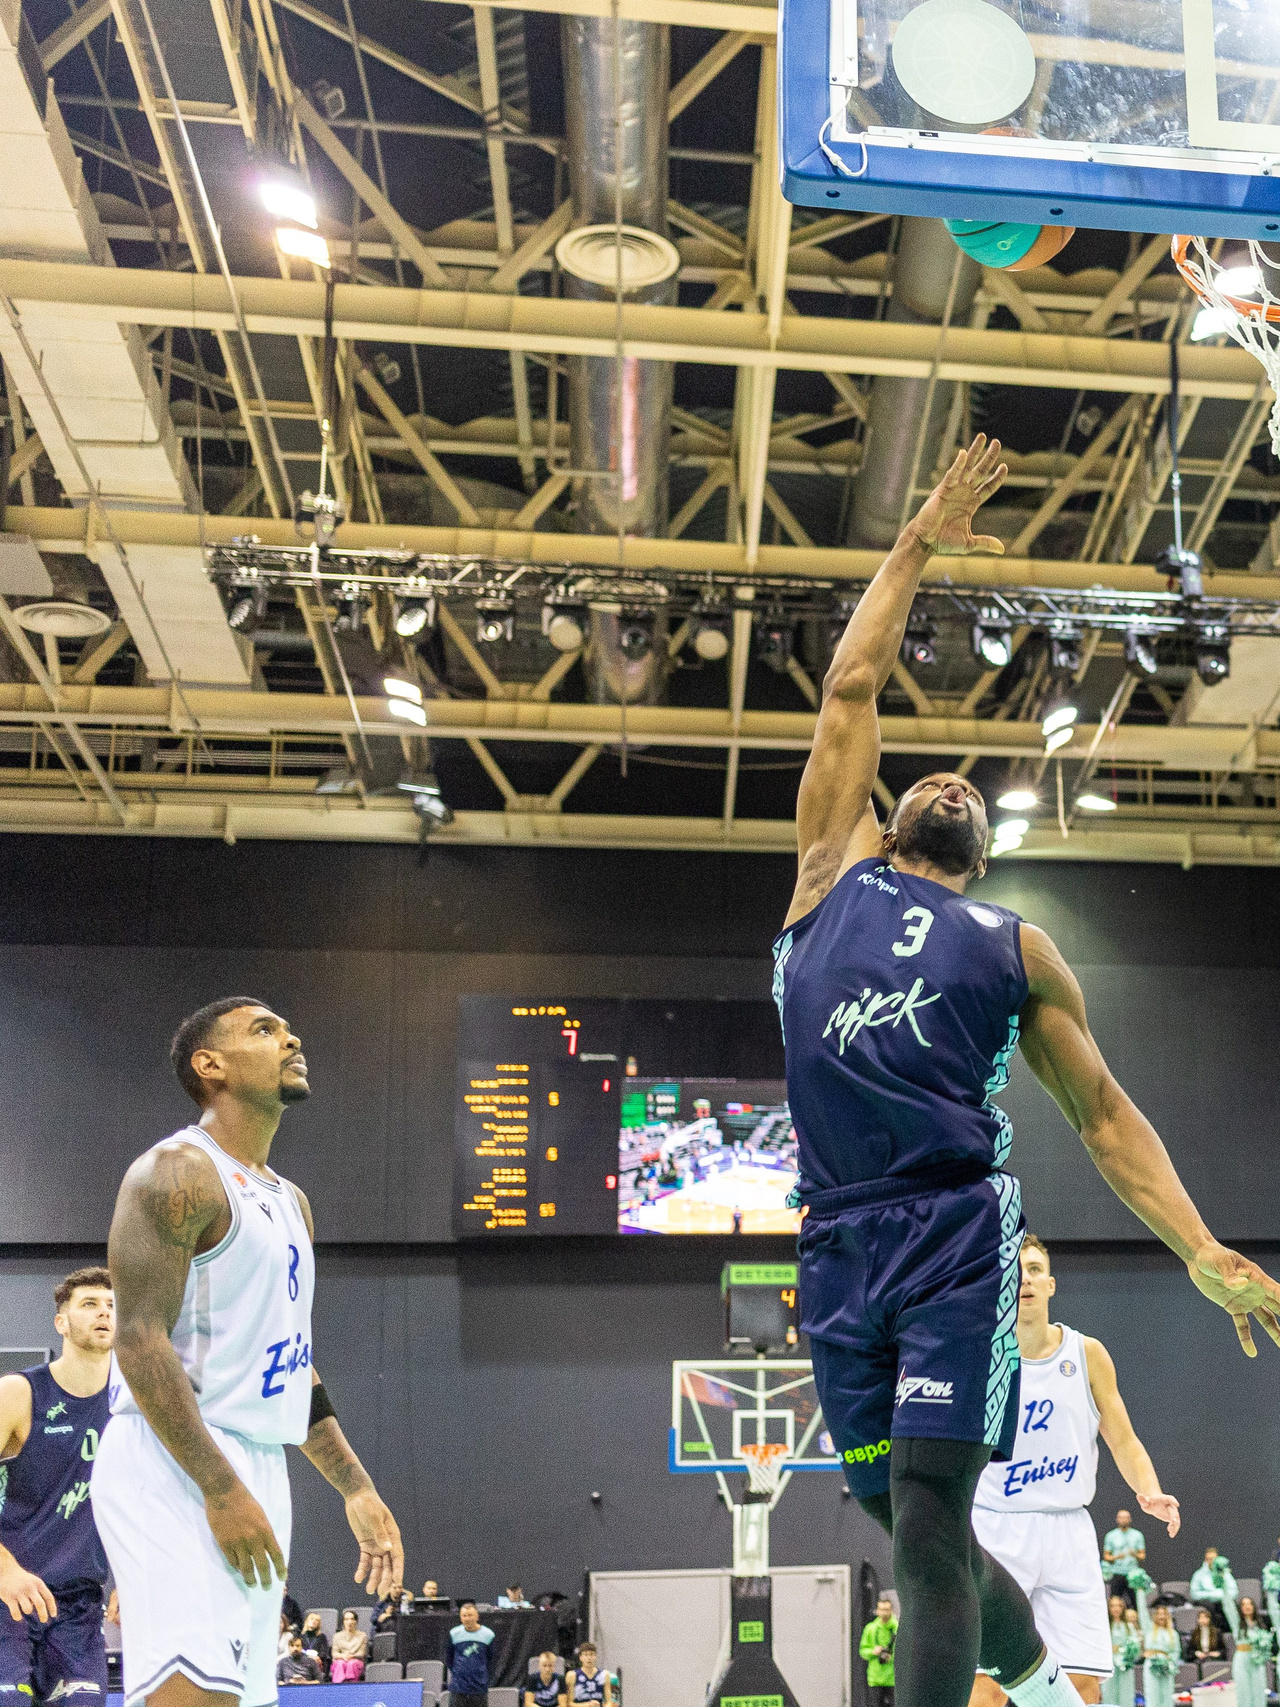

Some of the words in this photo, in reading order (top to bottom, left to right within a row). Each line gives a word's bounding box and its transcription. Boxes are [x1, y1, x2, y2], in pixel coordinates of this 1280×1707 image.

[891, 906, 935, 958] 3
[561, 1029, 578, 1056] 7
[288, 1244, 300, 1302] 8
[781, 1289, 796, 1309] 4
[1024, 1399, 1054, 1434] 12
[844, 1438, 893, 1465] евро
[1003, 1454, 1079, 1497] Enisey
